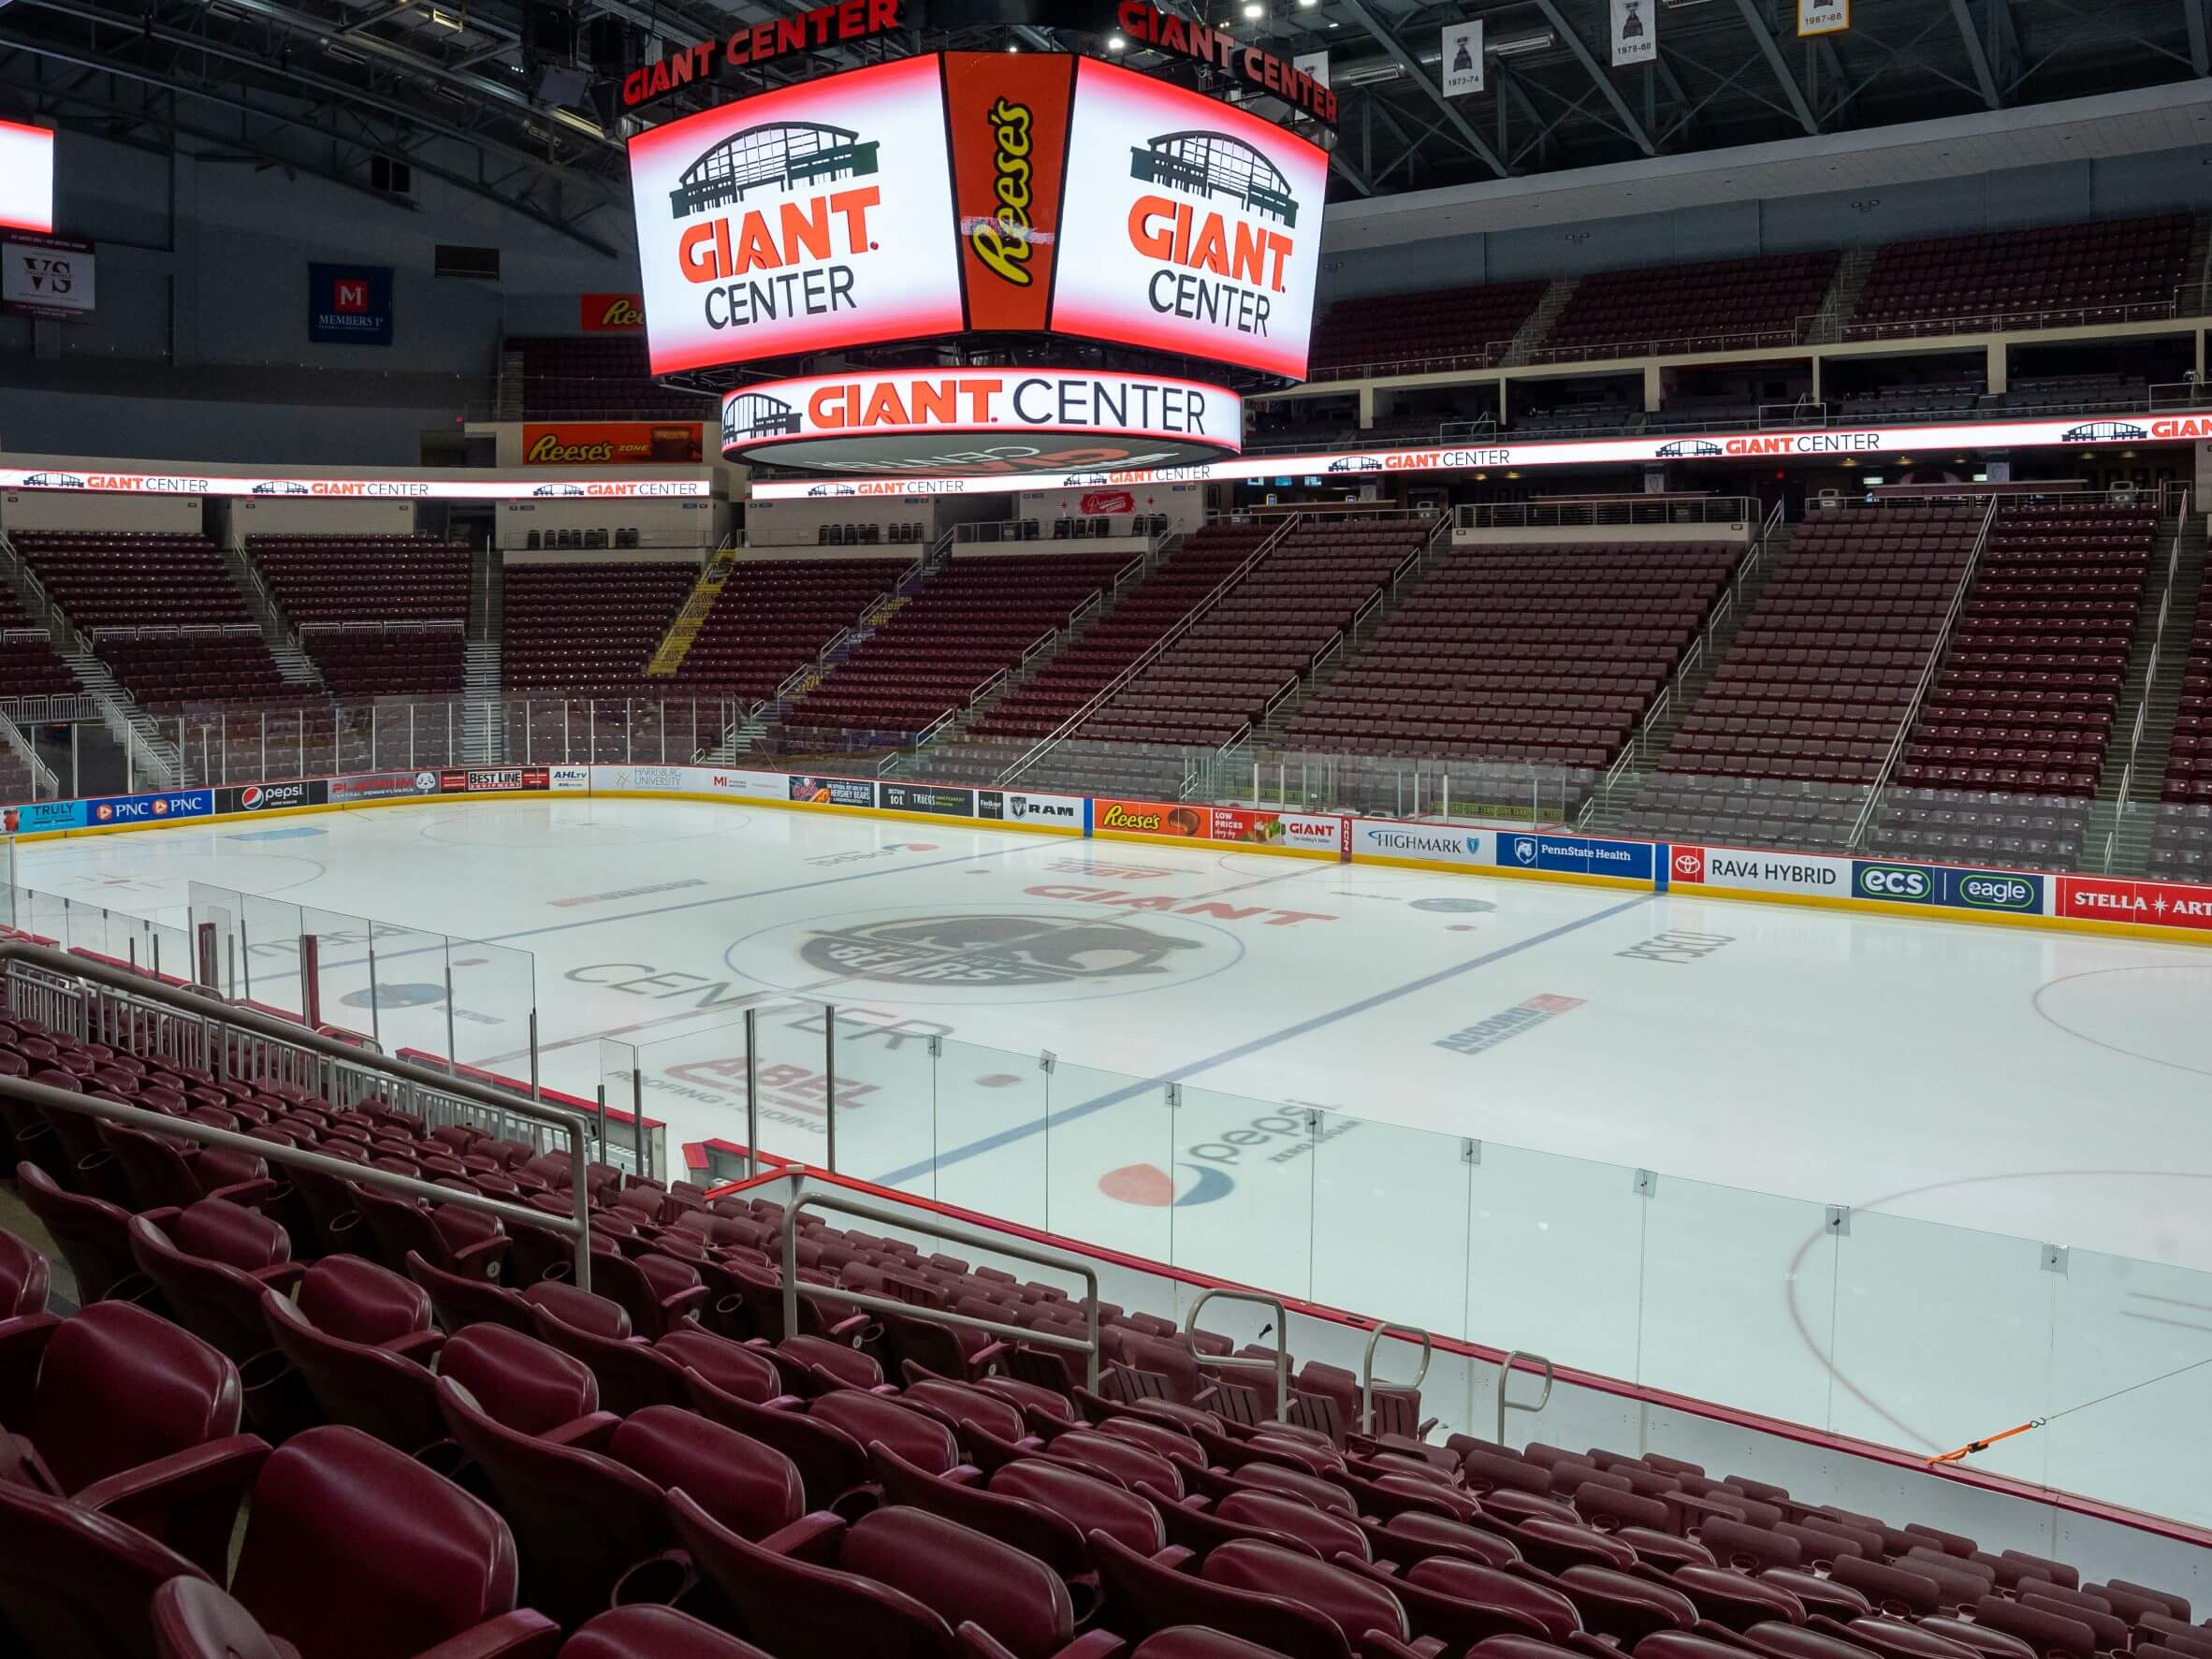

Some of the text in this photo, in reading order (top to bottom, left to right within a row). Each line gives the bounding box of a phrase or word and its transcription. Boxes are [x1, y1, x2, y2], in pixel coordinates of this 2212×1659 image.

[622, 0, 899, 105] GIANT CENTER
[1118, 1, 1338, 124] GIANT CENTER
[970, 97, 1033, 286] Reese's
[706, 265, 857, 330] CENTER
[1149, 269, 1271, 338] CENTER
[1012, 377, 1206, 436] CENTER
[530, 434, 614, 462] Reese's
[1725, 433, 1880, 455] GIANT CENTER
[1385, 449, 1510, 469] GIANT CENTER
[87, 475, 209, 492] GIANT CENTER
[1109, 466, 1210, 484] GIANT CENTER
[312, 483, 429, 496] GIANT CENTER
[587, 483, 697, 495] GIANT CENTER
[858, 480, 963, 494] GIANT CENTER
[470, 773, 496, 783] BEST
[499, 772, 521, 783] LINE
[265, 784, 303, 802] pepsi
[891, 795, 903, 806] 101
[33, 802, 75, 817] TRULY
[115, 802, 150, 817] PNC
[170, 797, 203, 811] PNC
[1029, 805, 1074, 817] RAM
[1102, 804, 1161, 830] Reese's
[1215, 821, 1243, 829] PRICES
[1289, 822, 1334, 836] GIANT
[1377, 833, 1462, 854] HIGHMARK
[1595, 849, 1631, 862] Health
[1711, 859, 1837, 885] RAV4 HYBRID
[1865, 870, 1925, 895] ecs
[1968, 880, 2026, 903] eagle
[1023, 884, 1341, 926] GIANT
[2074, 892, 2148, 910] STELLA
[564, 963, 954, 1050] CENTER
